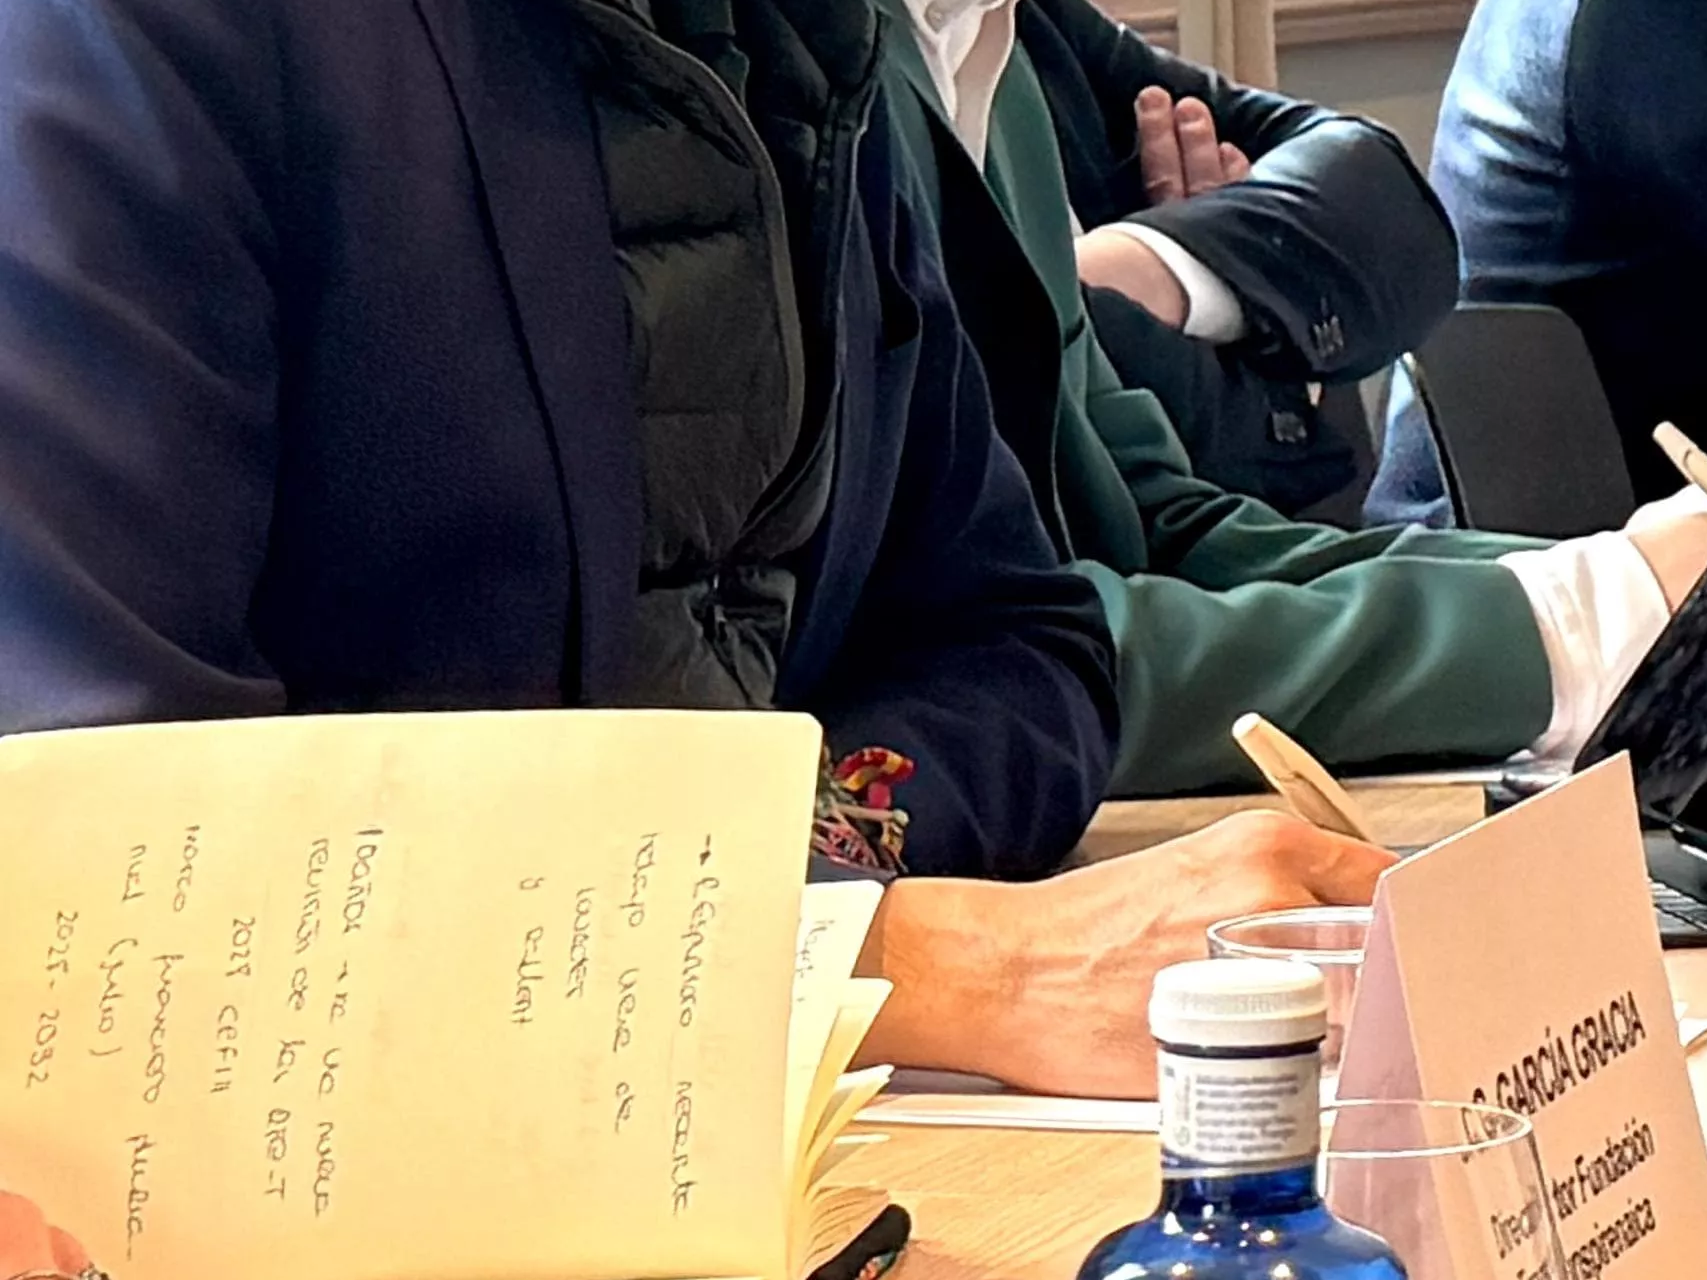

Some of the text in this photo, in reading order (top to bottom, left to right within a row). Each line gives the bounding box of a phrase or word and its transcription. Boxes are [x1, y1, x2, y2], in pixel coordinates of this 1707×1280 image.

[1496, 1025, 1577, 1116] GARCÍA
[1571, 989, 1647, 1080] GRACIA
[1574, 1117, 1655, 1204] Fundación
